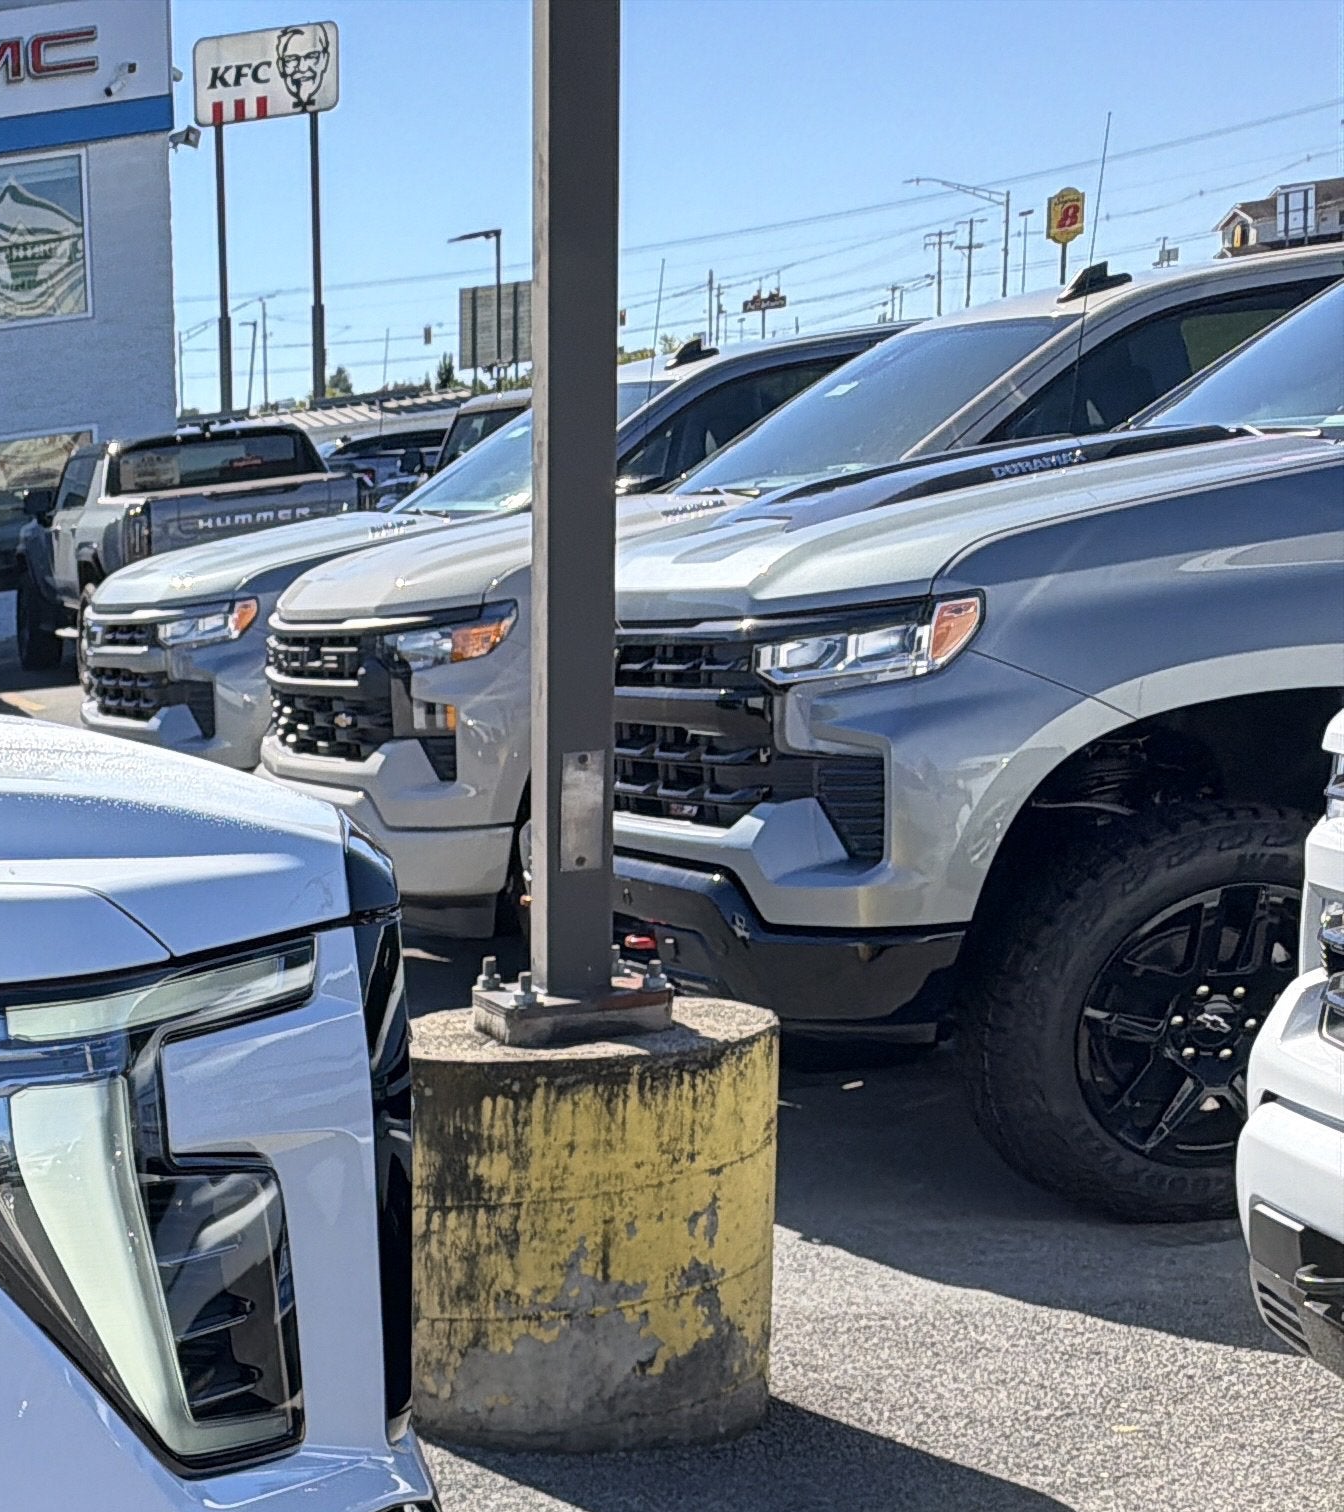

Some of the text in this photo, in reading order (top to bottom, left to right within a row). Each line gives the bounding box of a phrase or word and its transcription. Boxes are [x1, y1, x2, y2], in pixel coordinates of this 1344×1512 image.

[207, 60, 272, 90] KFC
[1056, 203, 1080, 229] 8
[197, 506, 311, 529] HUMMER
